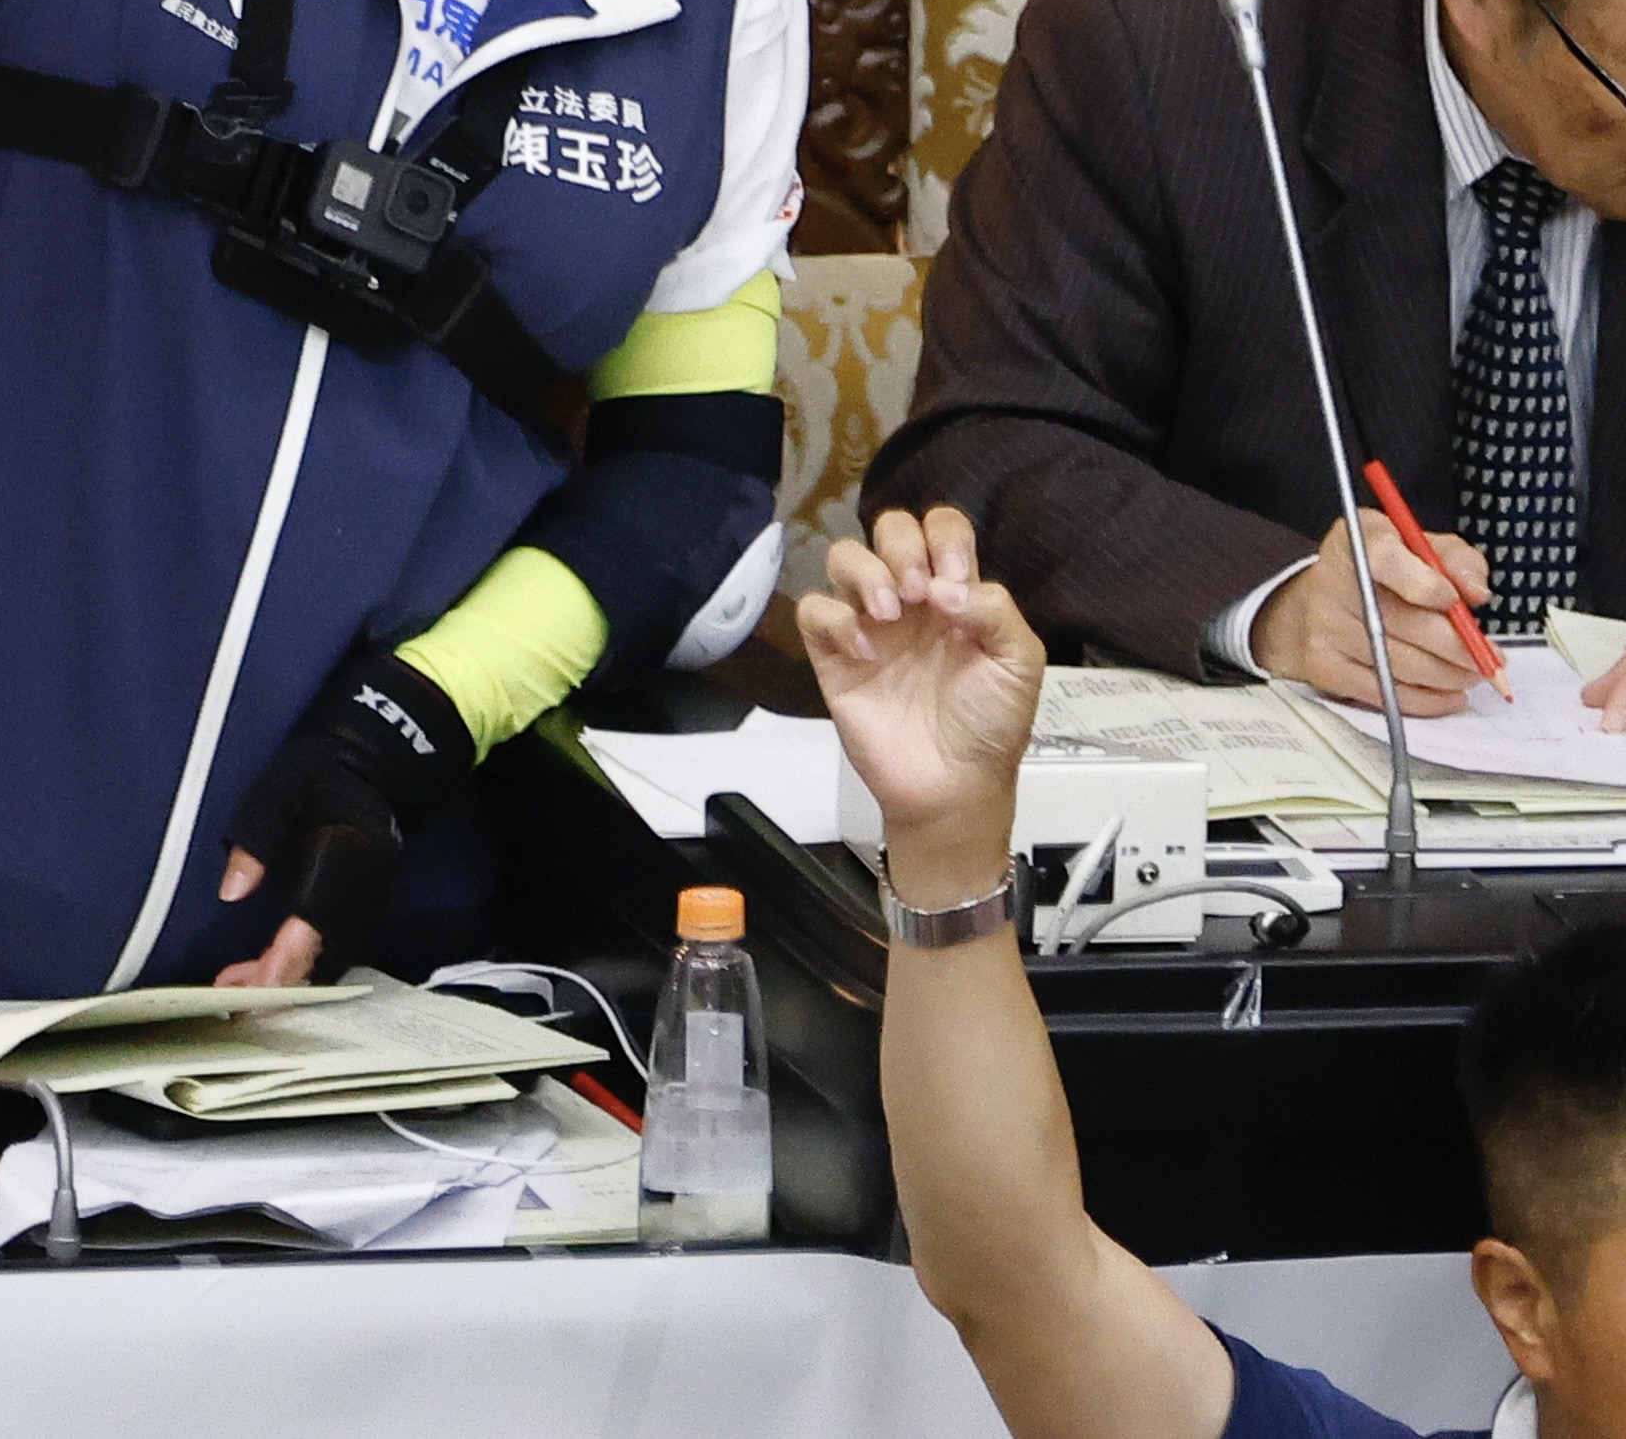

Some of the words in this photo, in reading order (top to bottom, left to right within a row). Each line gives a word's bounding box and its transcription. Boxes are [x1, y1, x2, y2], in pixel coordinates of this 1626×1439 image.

[519, 85, 646, 134] 立法委員
[502, 117, 663, 203] 陳玉珍
[353, 684, 437, 755] ALEX
